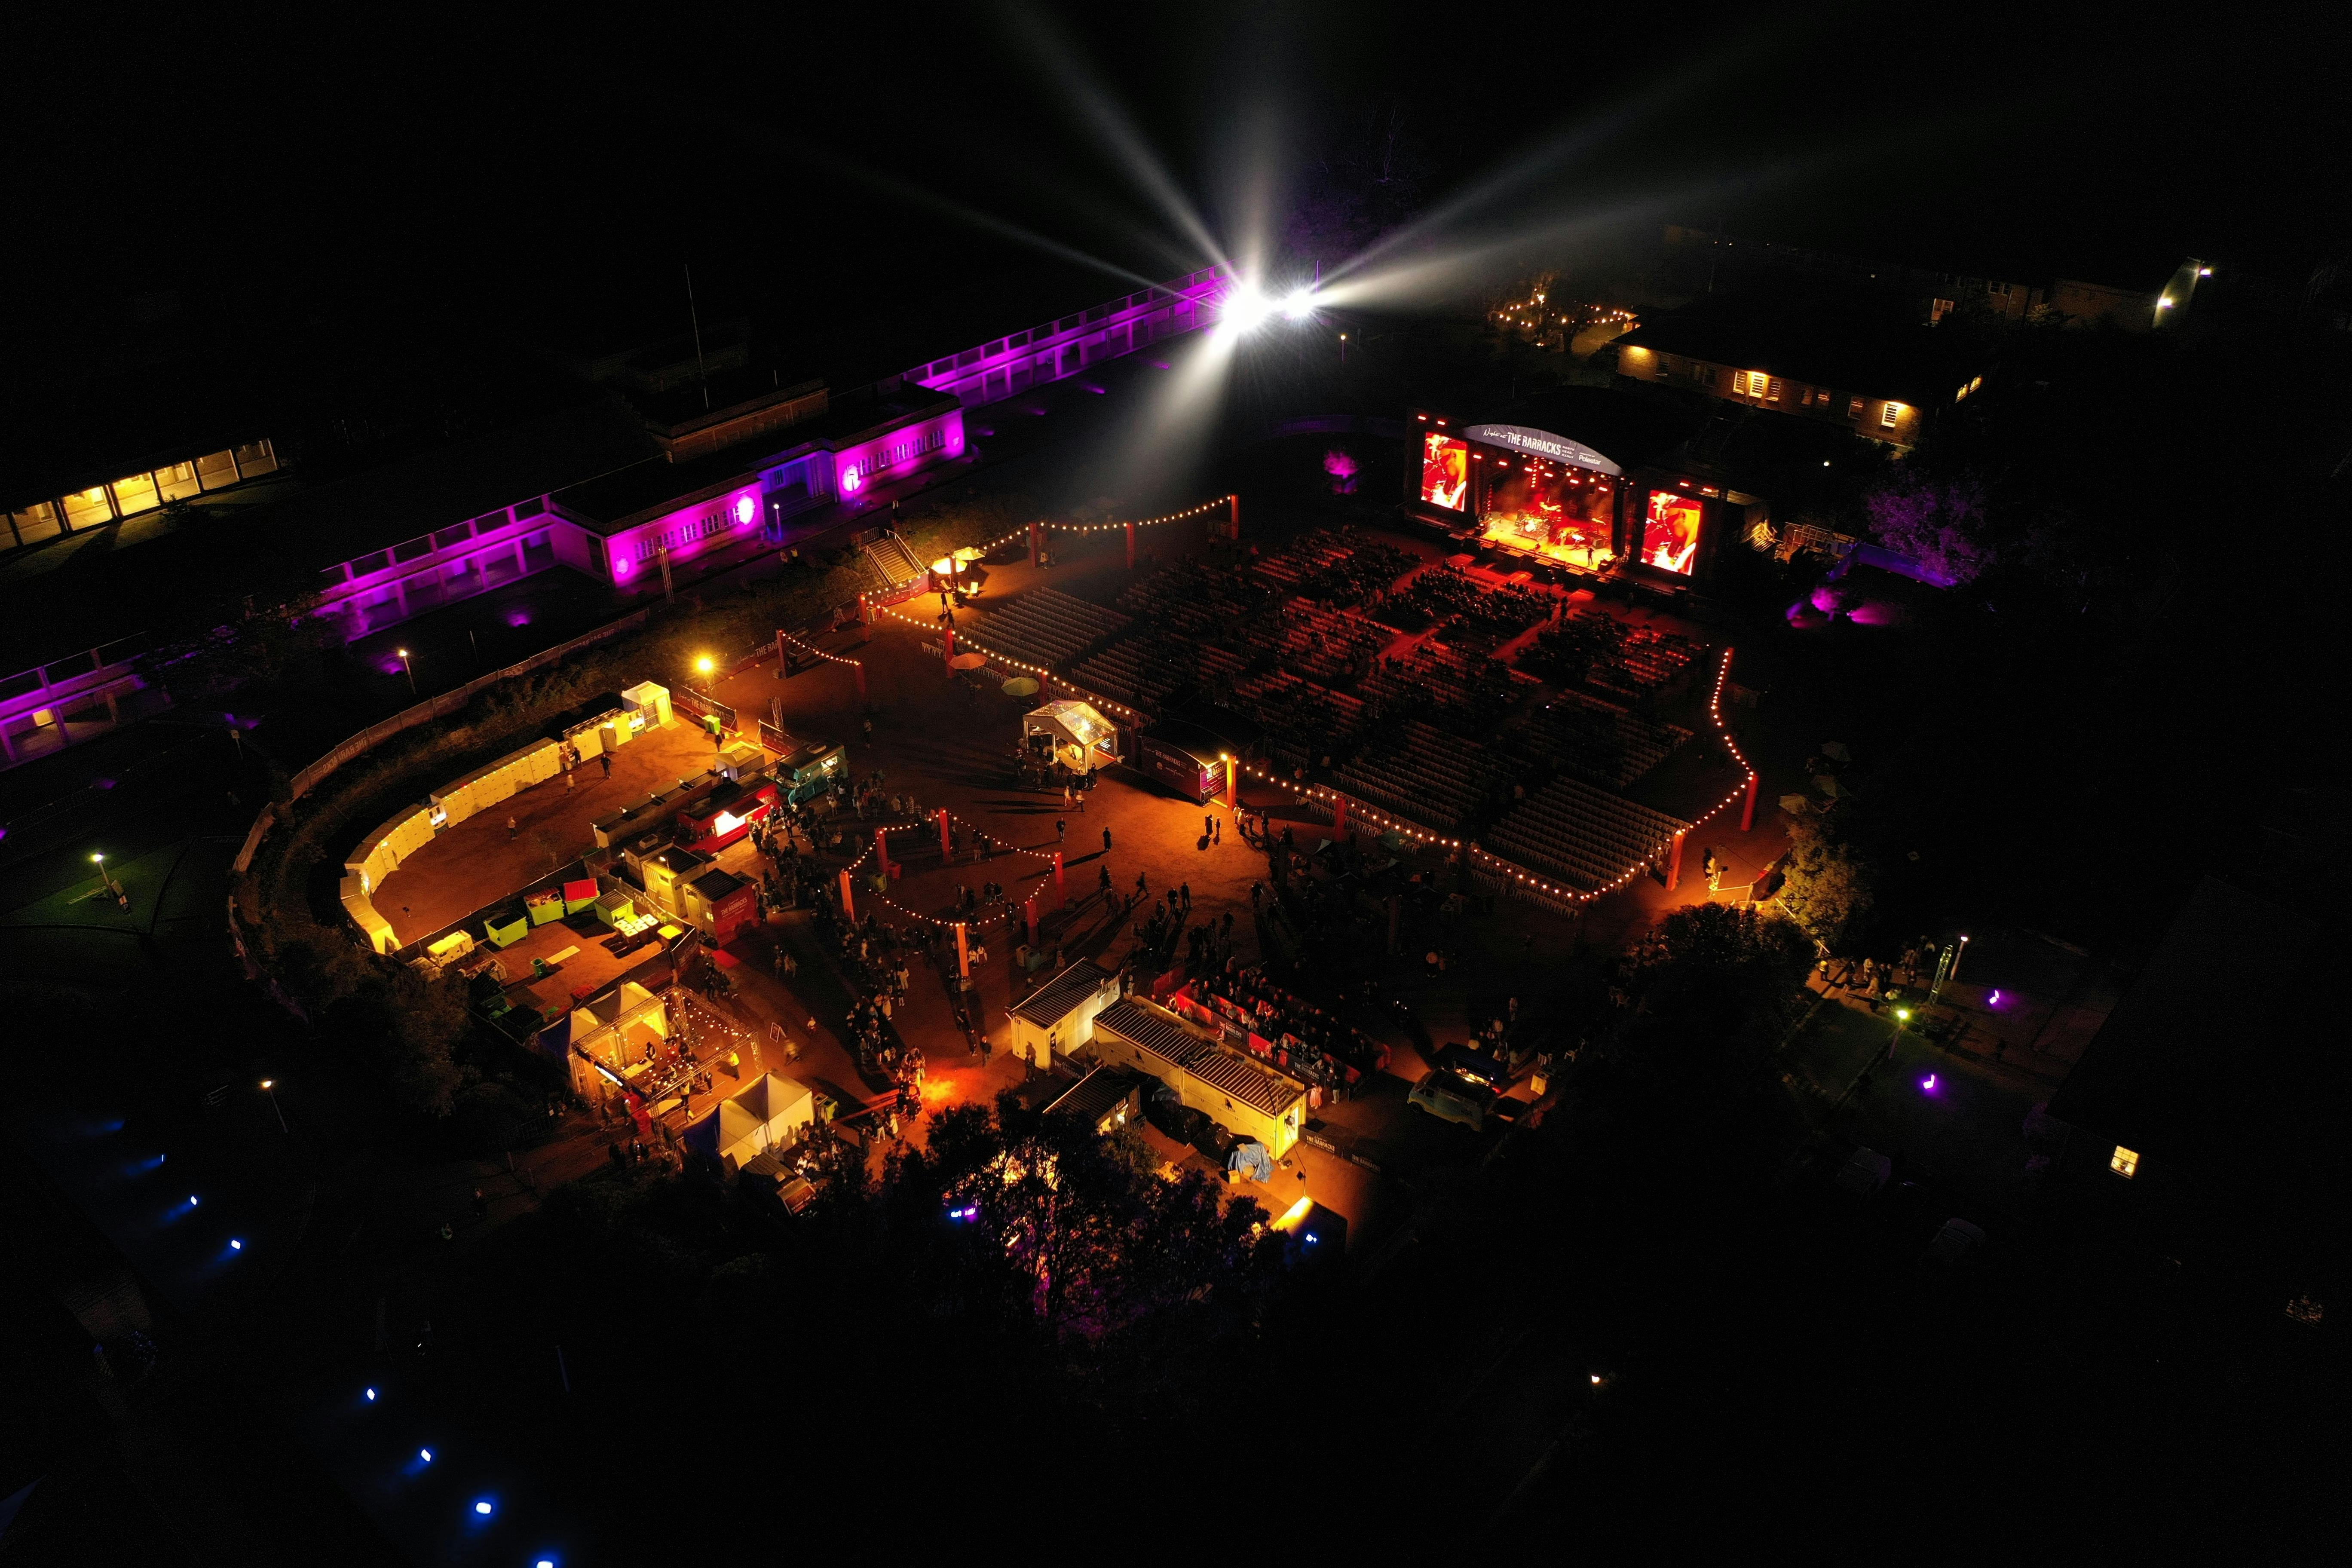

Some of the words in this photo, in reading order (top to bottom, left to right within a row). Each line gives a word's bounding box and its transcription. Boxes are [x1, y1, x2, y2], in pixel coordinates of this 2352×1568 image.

[1507, 432, 1522, 446] THE
[1522, 436, 1561, 456] BARRACKS
[1579, 454, 1602, 465] Polestar
[755, 645, 767, 657] THE
[690, 697, 700, 710] THE
